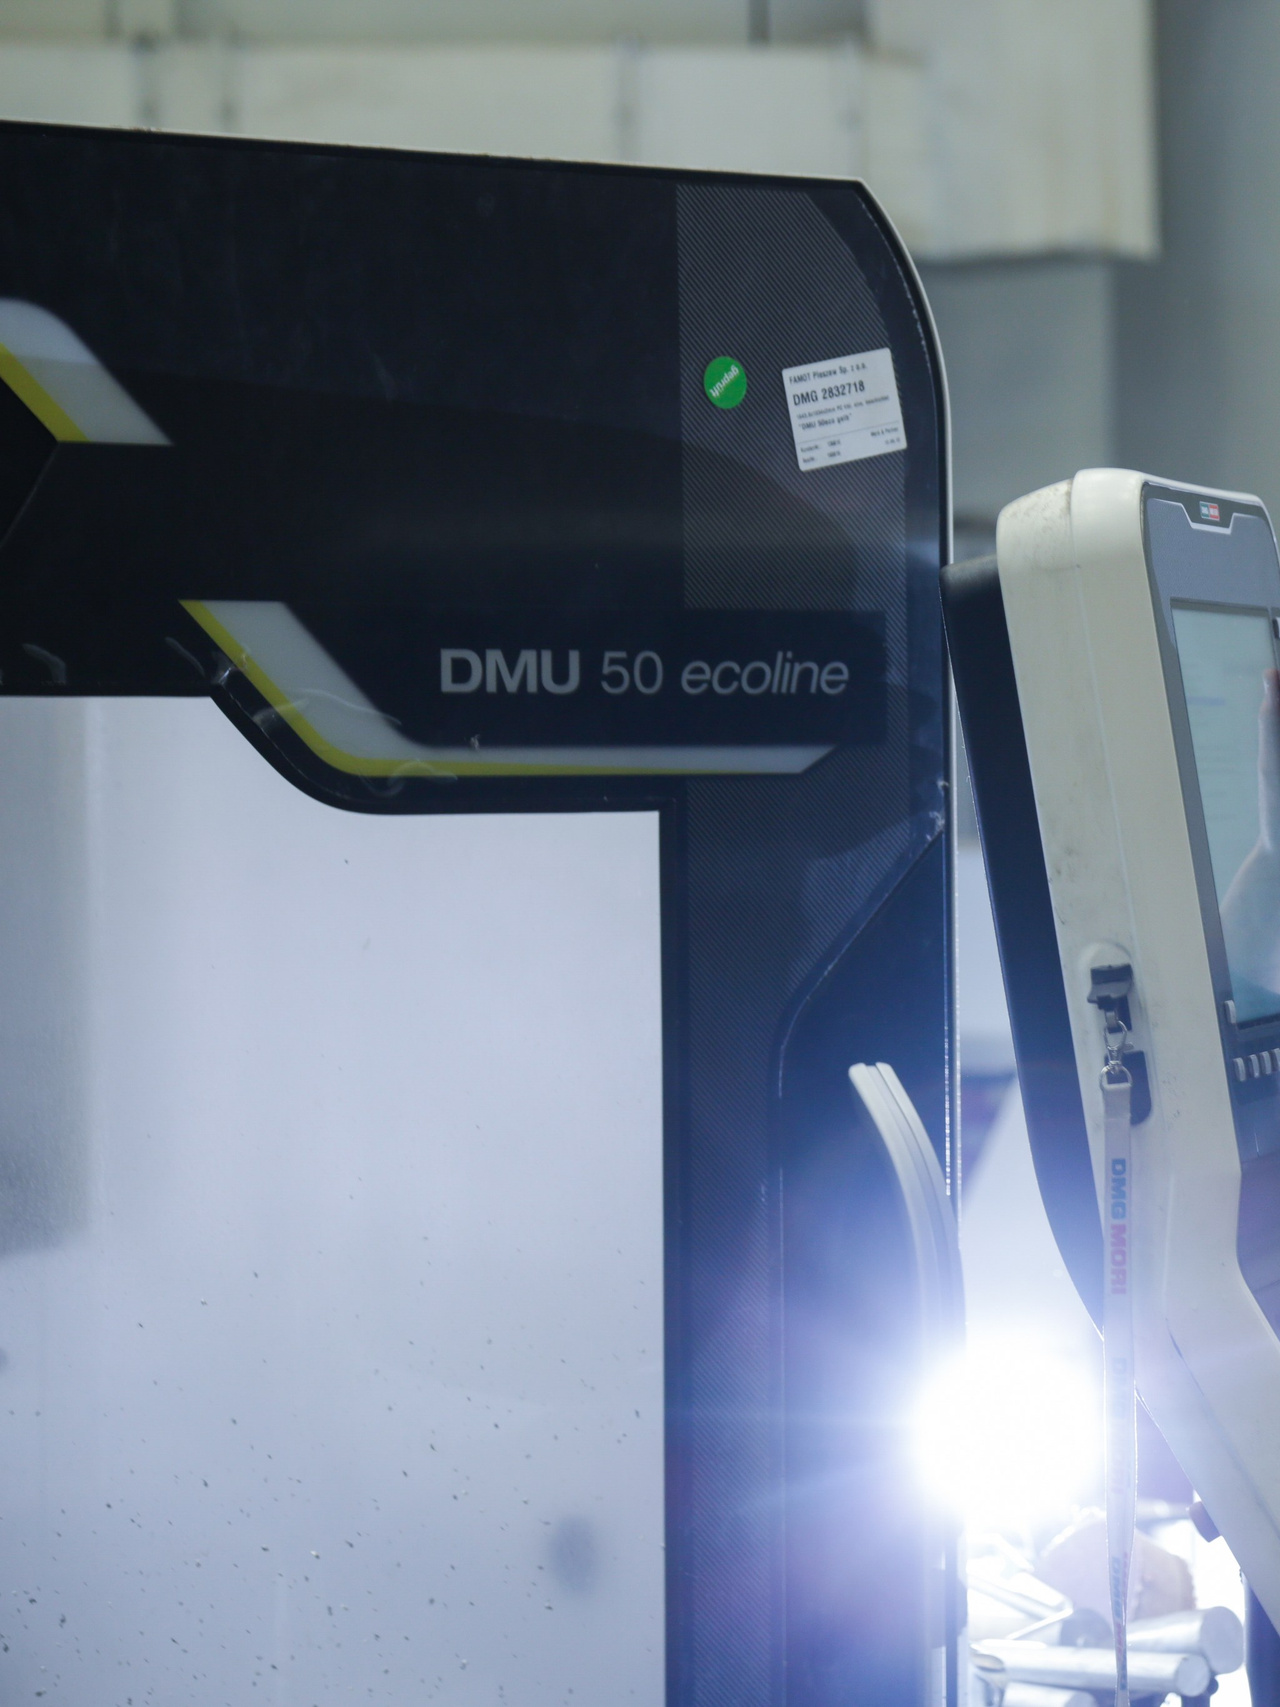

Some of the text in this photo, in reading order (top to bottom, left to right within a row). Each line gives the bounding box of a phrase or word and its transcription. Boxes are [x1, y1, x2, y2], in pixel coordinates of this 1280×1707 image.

[792, 380, 865, 406] DMG 2832718
[440, 648, 850, 696] DMU 50 ecoline
[1110, 1157, 1127, 1295] DMG MORI
